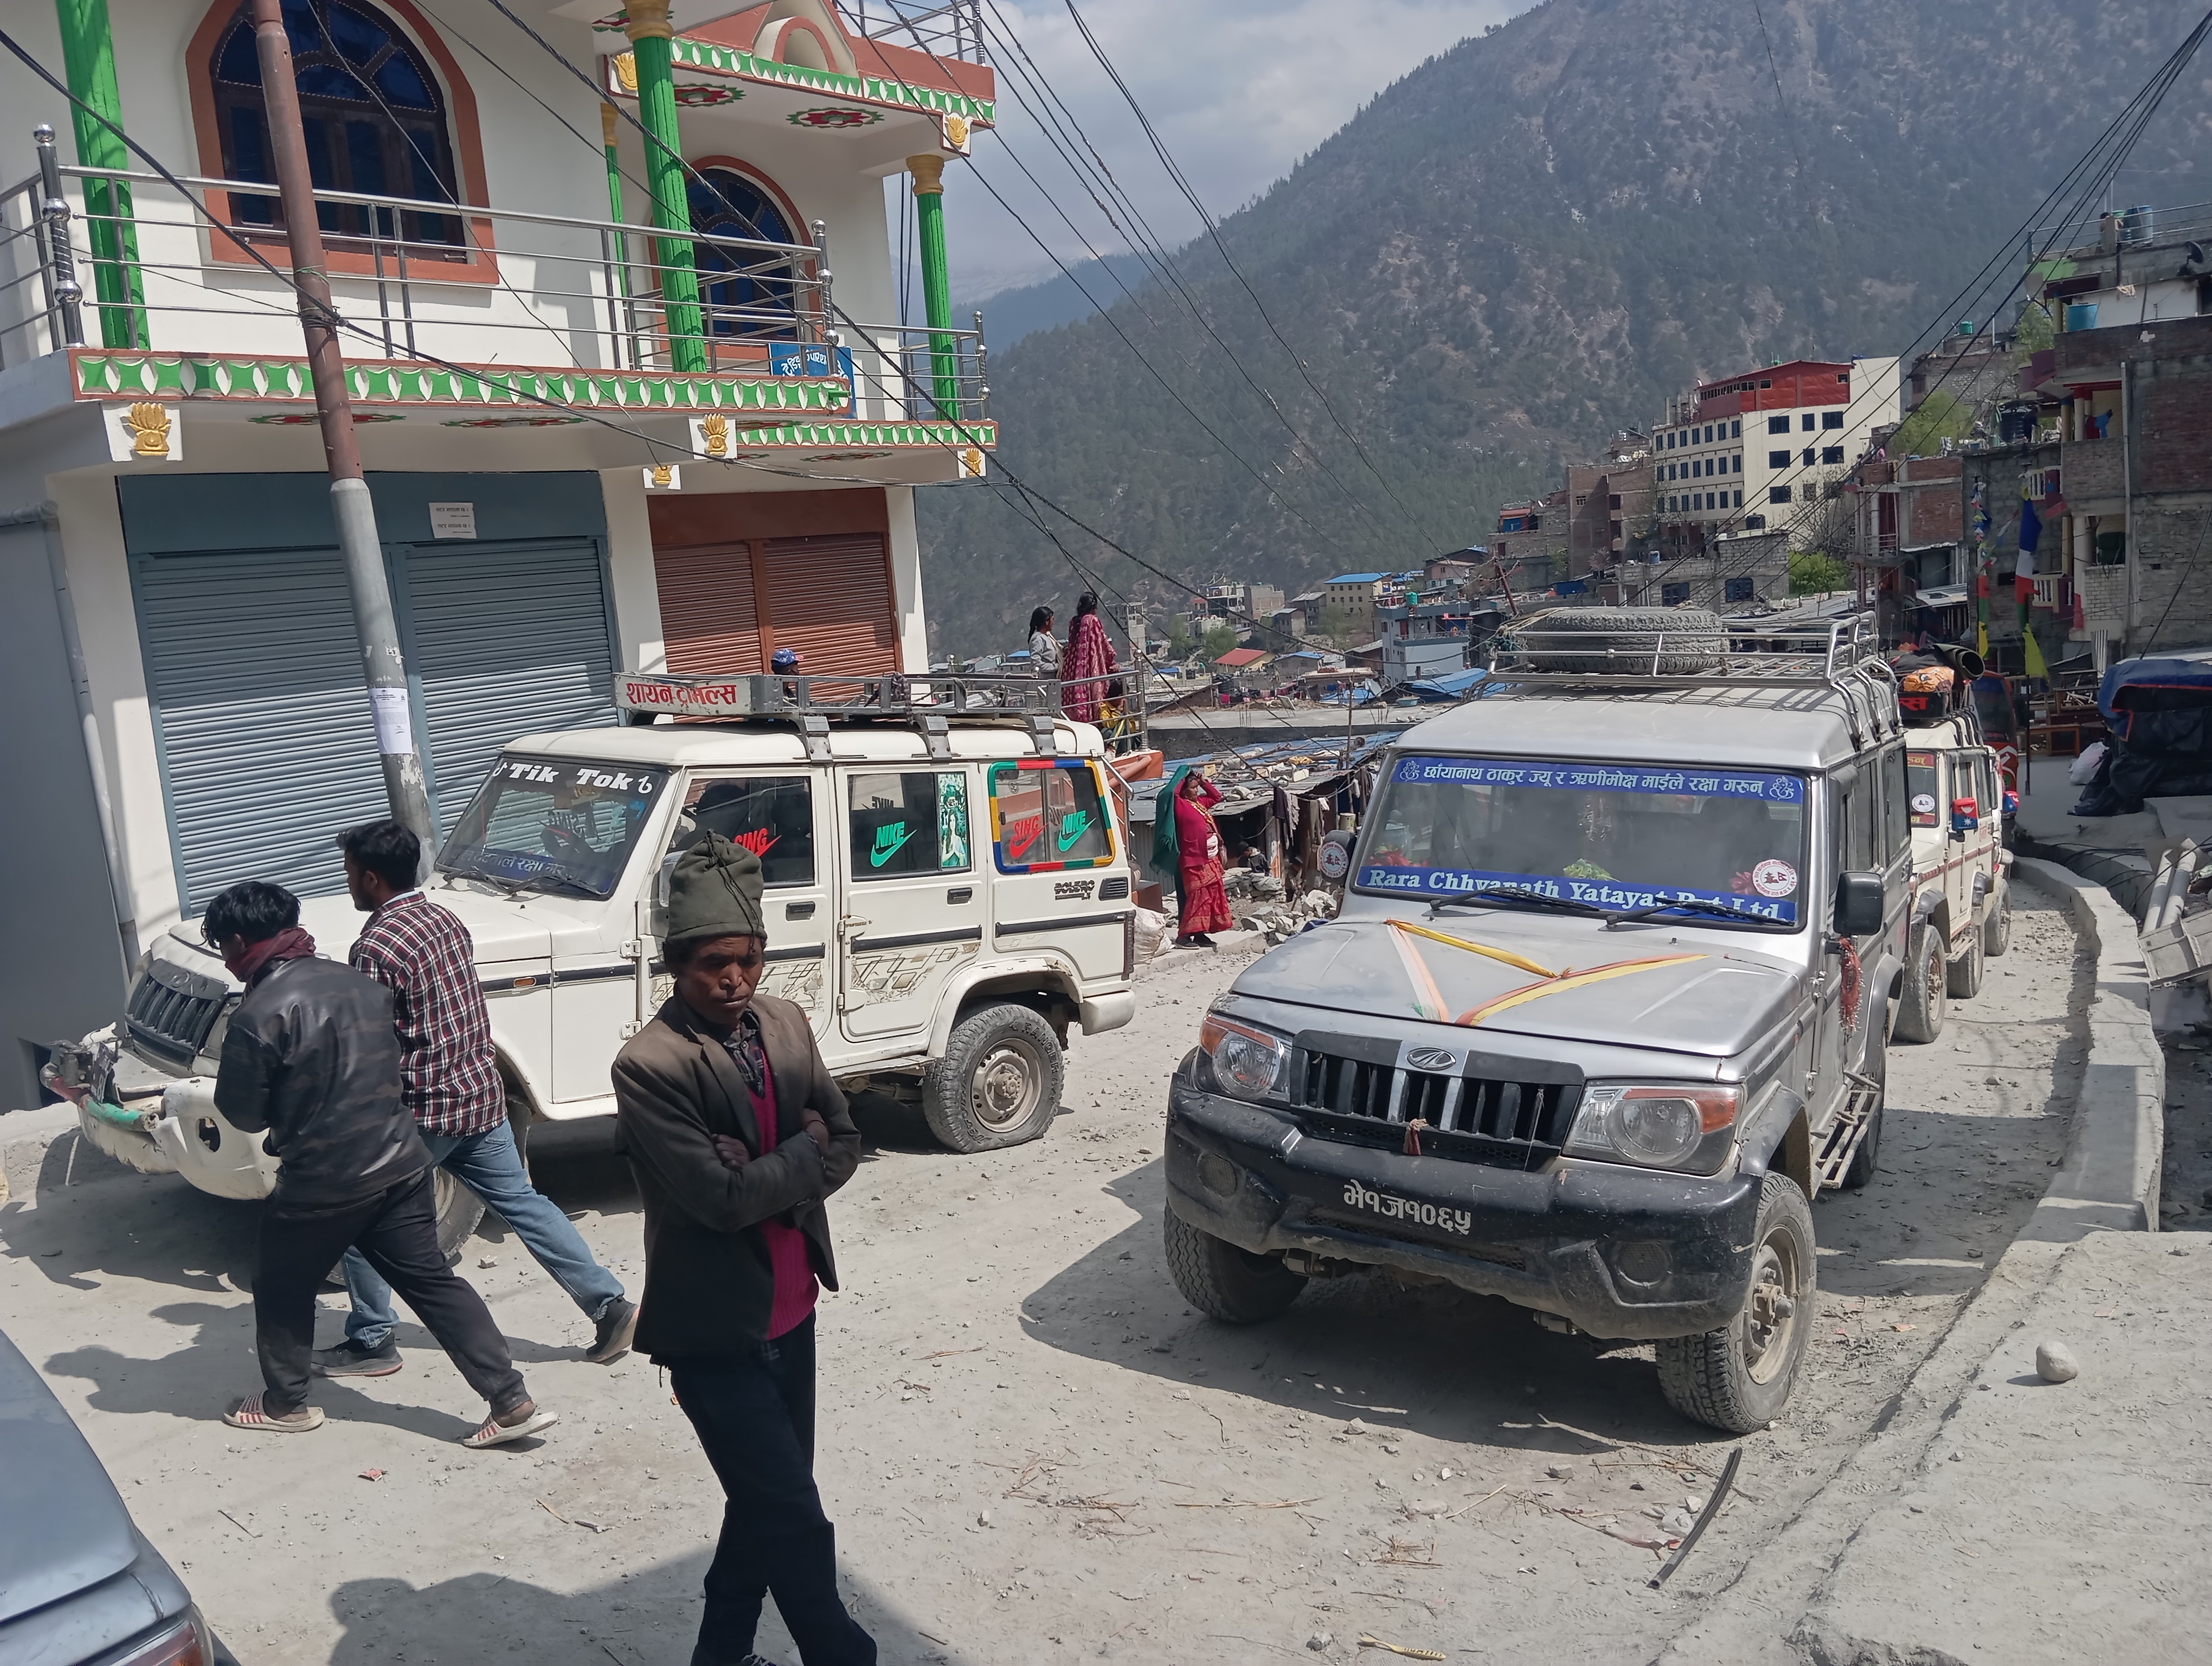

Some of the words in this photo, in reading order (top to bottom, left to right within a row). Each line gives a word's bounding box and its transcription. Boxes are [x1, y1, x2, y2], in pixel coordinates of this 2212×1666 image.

[626, 683, 673, 704] शायन
[509, 760, 560, 783] Tik
[576, 765, 634, 791] Tok
[1486, 767, 1527, 785] ठाकुर
[1528, 770, 1554, 787] ज्यू
[1555, 772, 1567, 785] र
[1641, 772, 1685, 791] माईले
[1688, 777, 1720, 793] रक्षा
[876, 821, 905, 849] NIKE
[1013, 815, 1039, 841] SING
[1062, 810, 1086, 835] NIKE
[1367, 869, 1421, 888] Rara
[1568, 881, 1666, 909] Yatayat
